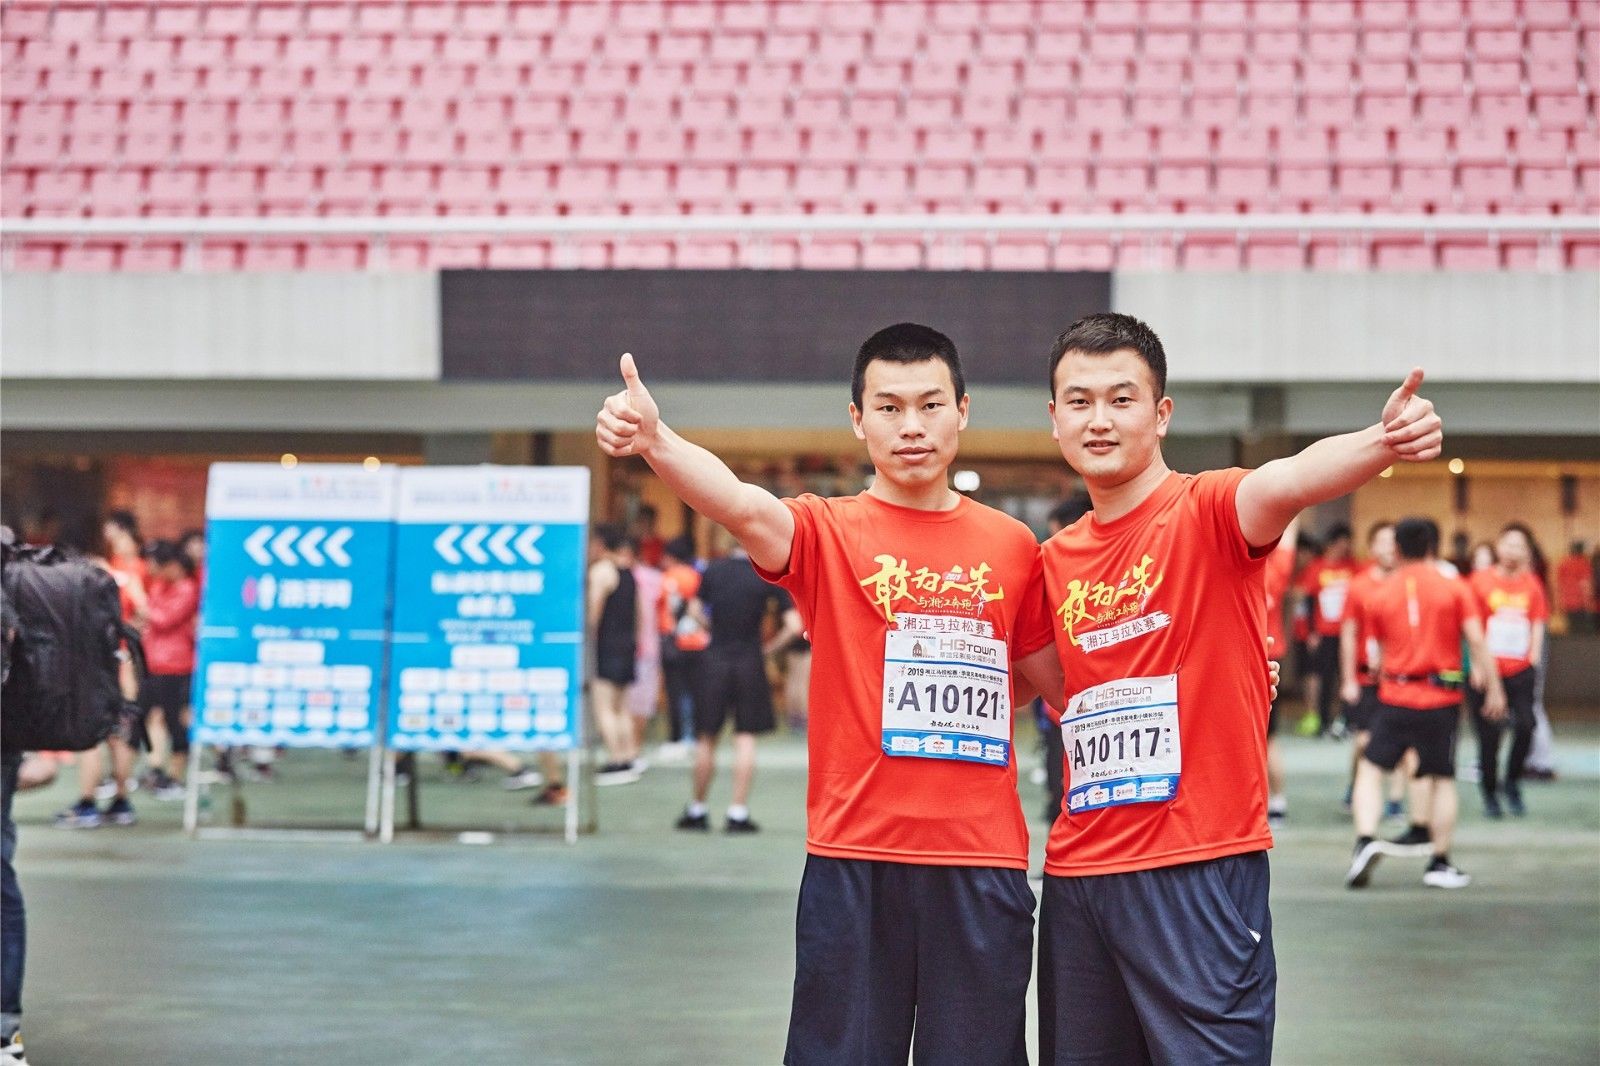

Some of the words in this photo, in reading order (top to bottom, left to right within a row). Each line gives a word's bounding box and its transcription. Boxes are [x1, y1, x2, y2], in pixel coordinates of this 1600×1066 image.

[903, 616, 987, 635] 湘江马拉松赛
[1086, 616, 1156, 649] 湘江马拉松赛
[907, 667, 924, 677] 2019
[897, 681, 999, 720] A10121
[1074, 723, 1086, 734] 2019
[1074, 727, 1160, 770] A10117
